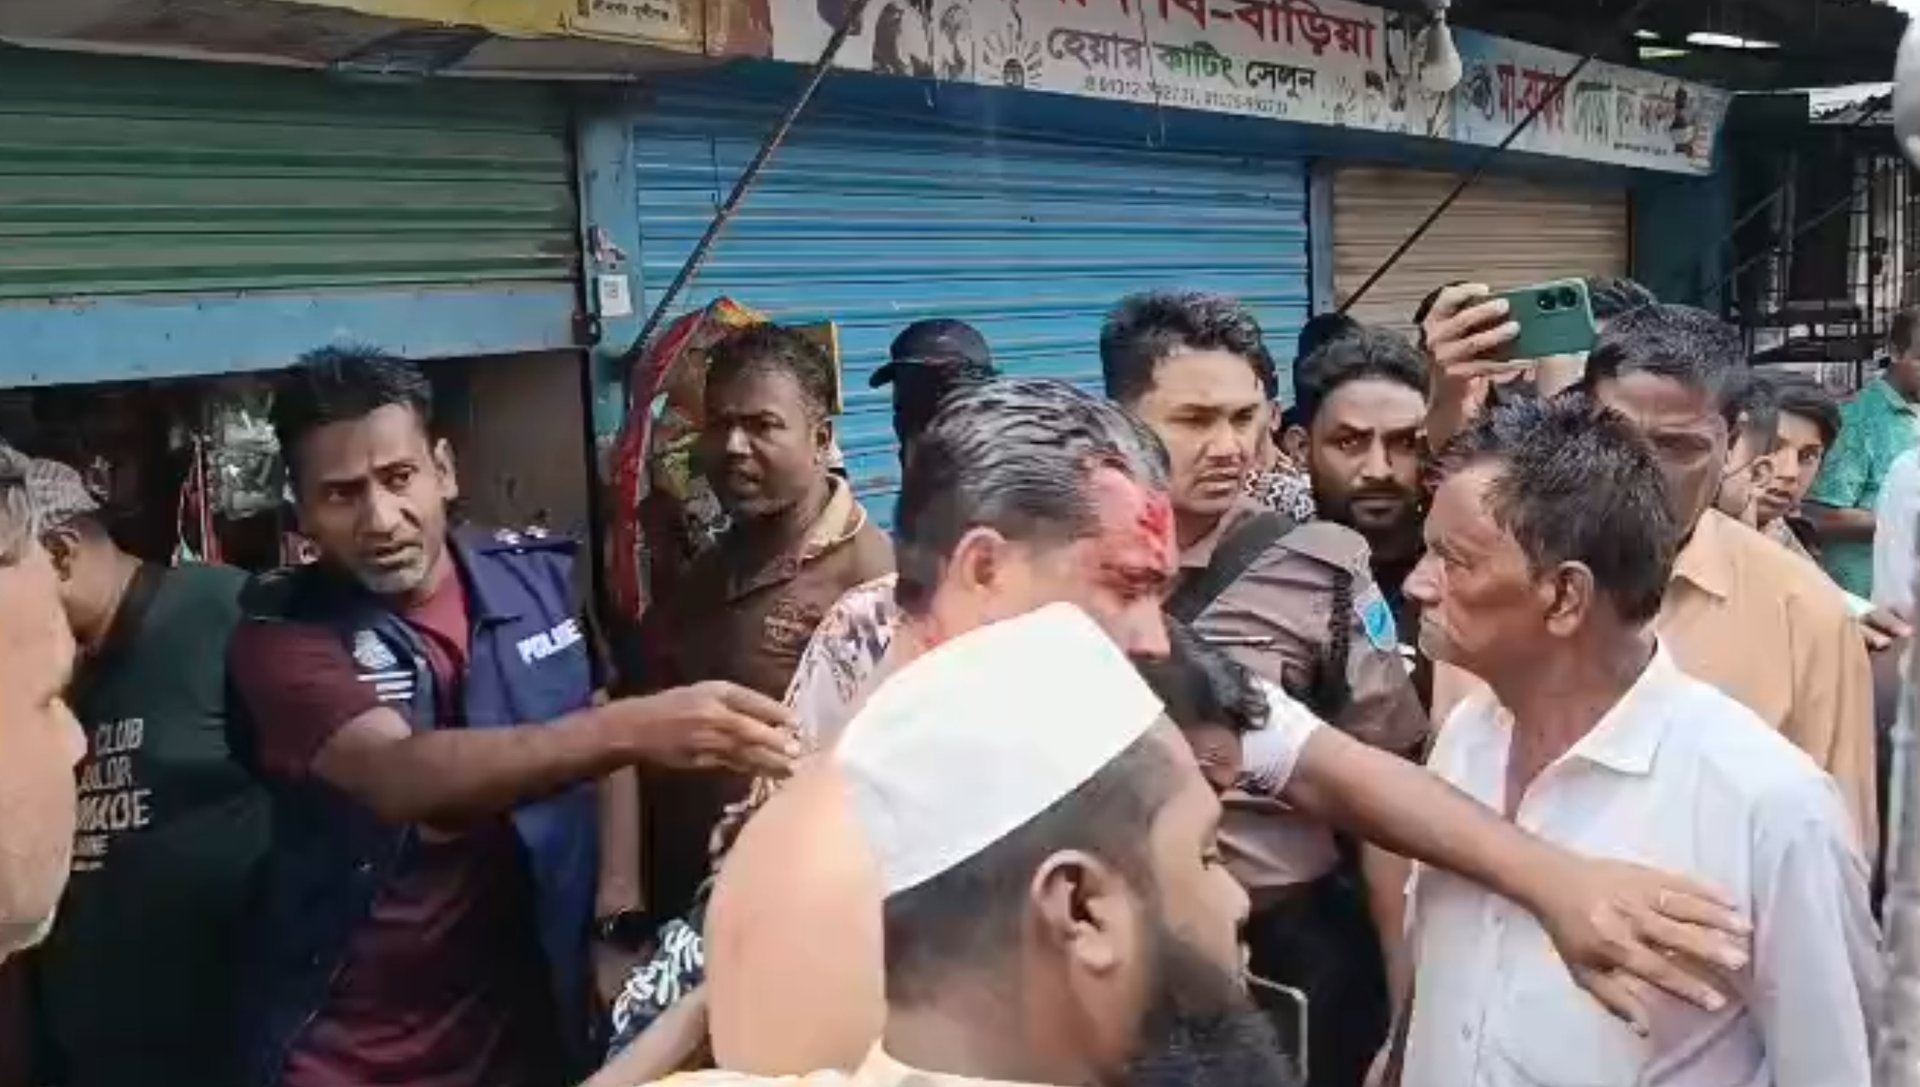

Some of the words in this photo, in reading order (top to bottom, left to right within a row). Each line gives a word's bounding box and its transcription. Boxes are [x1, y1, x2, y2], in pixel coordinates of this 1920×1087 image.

[1048, 27, 1143, 70] হেয়ার
[1152, 40, 1237, 87] কাটিং
[1246, 60, 1316, 98] সেলুন
